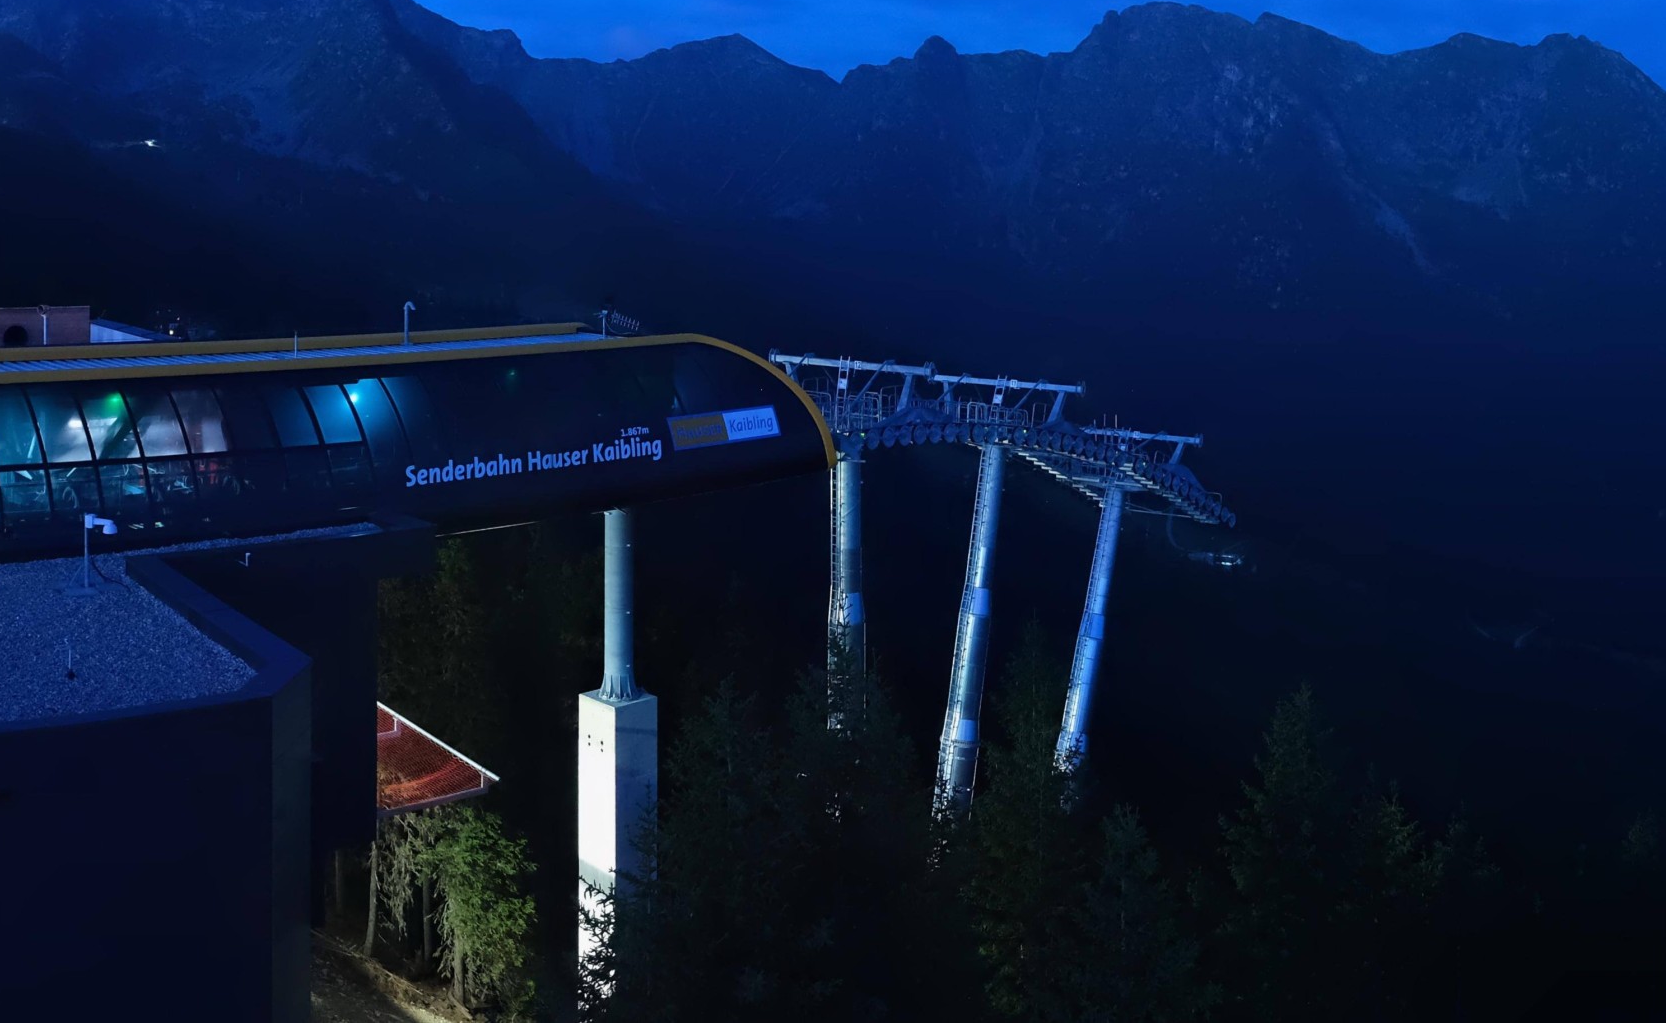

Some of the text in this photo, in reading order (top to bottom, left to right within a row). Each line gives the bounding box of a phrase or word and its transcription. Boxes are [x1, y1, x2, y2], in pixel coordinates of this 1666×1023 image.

[620, 426, 649, 437] 1.867m
[729, 416, 773, 433] Kaibling
[405, 437, 662, 487] Senderbahn Hauser Kaibling
